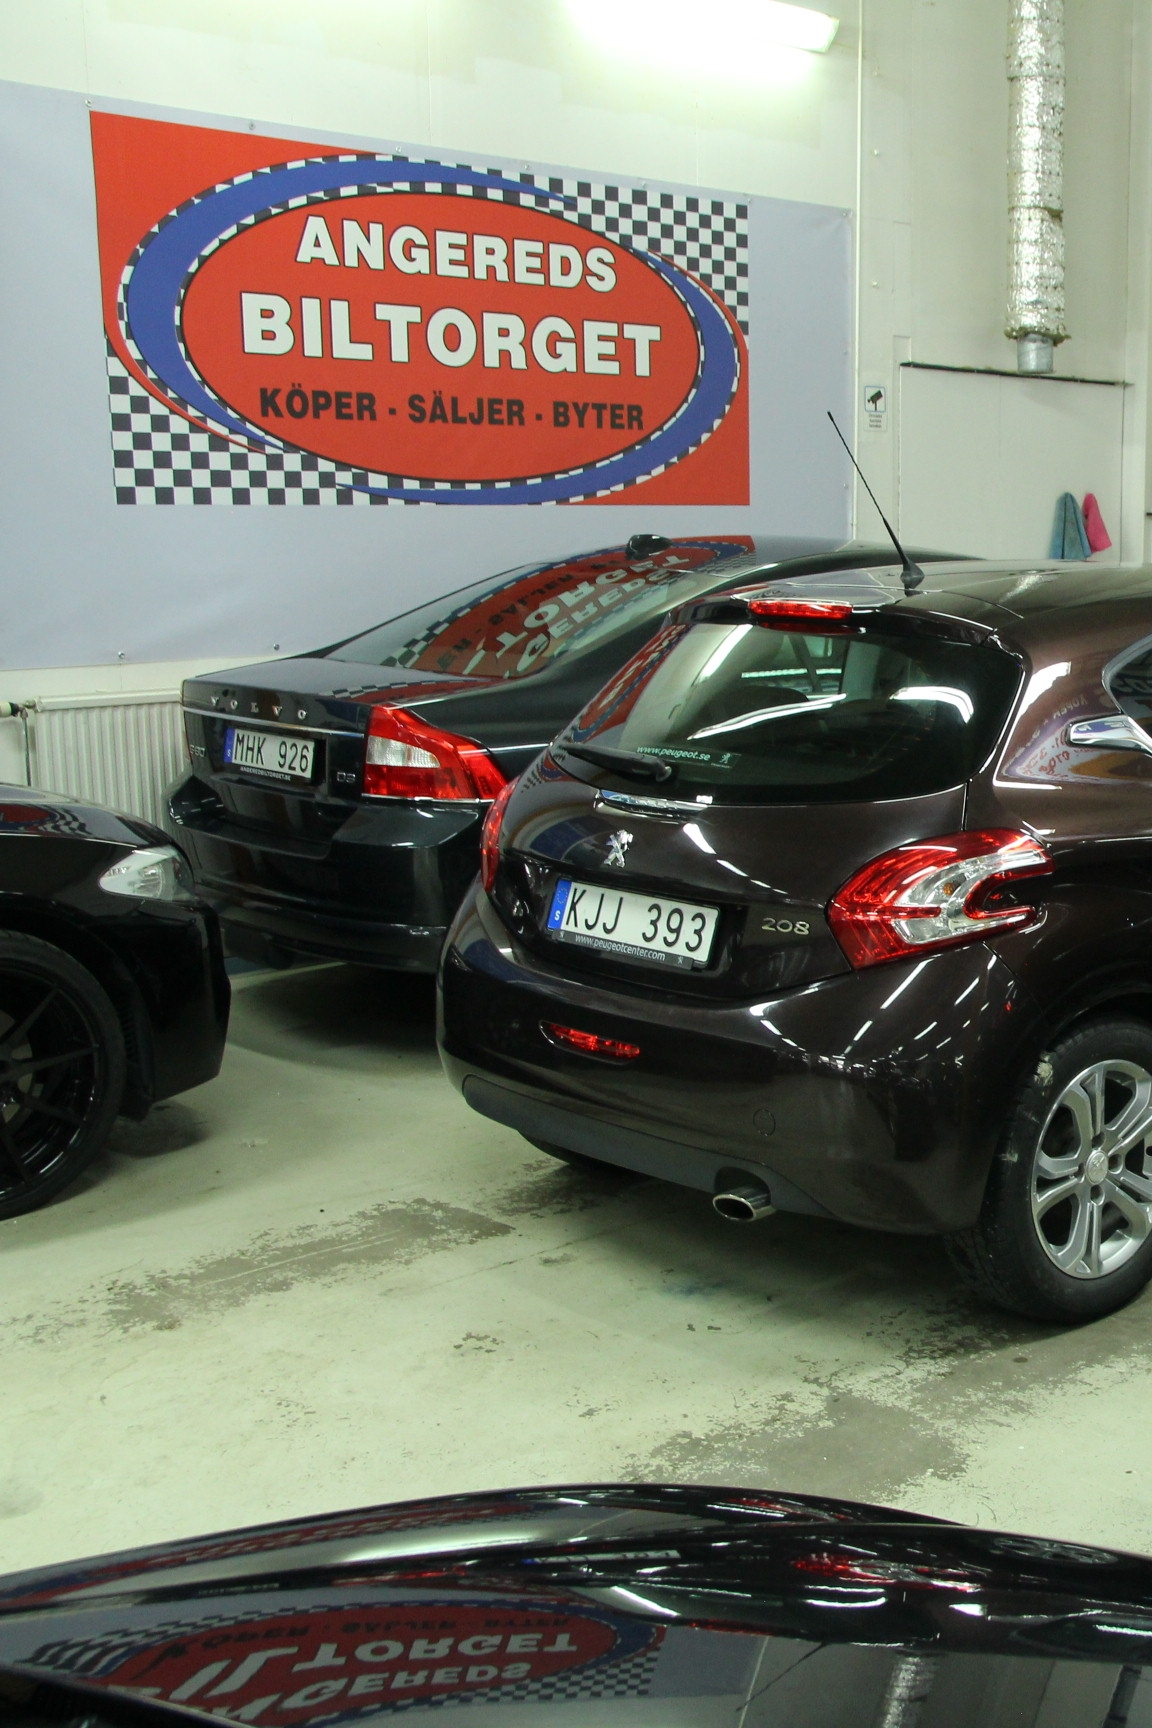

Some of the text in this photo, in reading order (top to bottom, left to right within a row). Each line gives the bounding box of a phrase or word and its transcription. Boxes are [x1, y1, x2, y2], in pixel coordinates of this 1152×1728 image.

[295, 214, 618, 293] ANGEREDS
[240, 291, 662, 378] BILTORGET
[259, 383, 377, 422] KÖPER
[408, 391, 526, 427] SÄLJER
[552, 401, 644, 431] BYTER
[210, 695, 307, 720] VOLVO
[234, 732, 267, 766] MHK
[277, 740, 310, 773] 926
[636, 746, 711, 761] www.peugeot.se
[565, 887, 624, 935] KJJ
[641, 903, 707, 952] 393
[761, 917, 810, 936] 208
[575, 934, 667, 962] www.peugeotcenter.com
